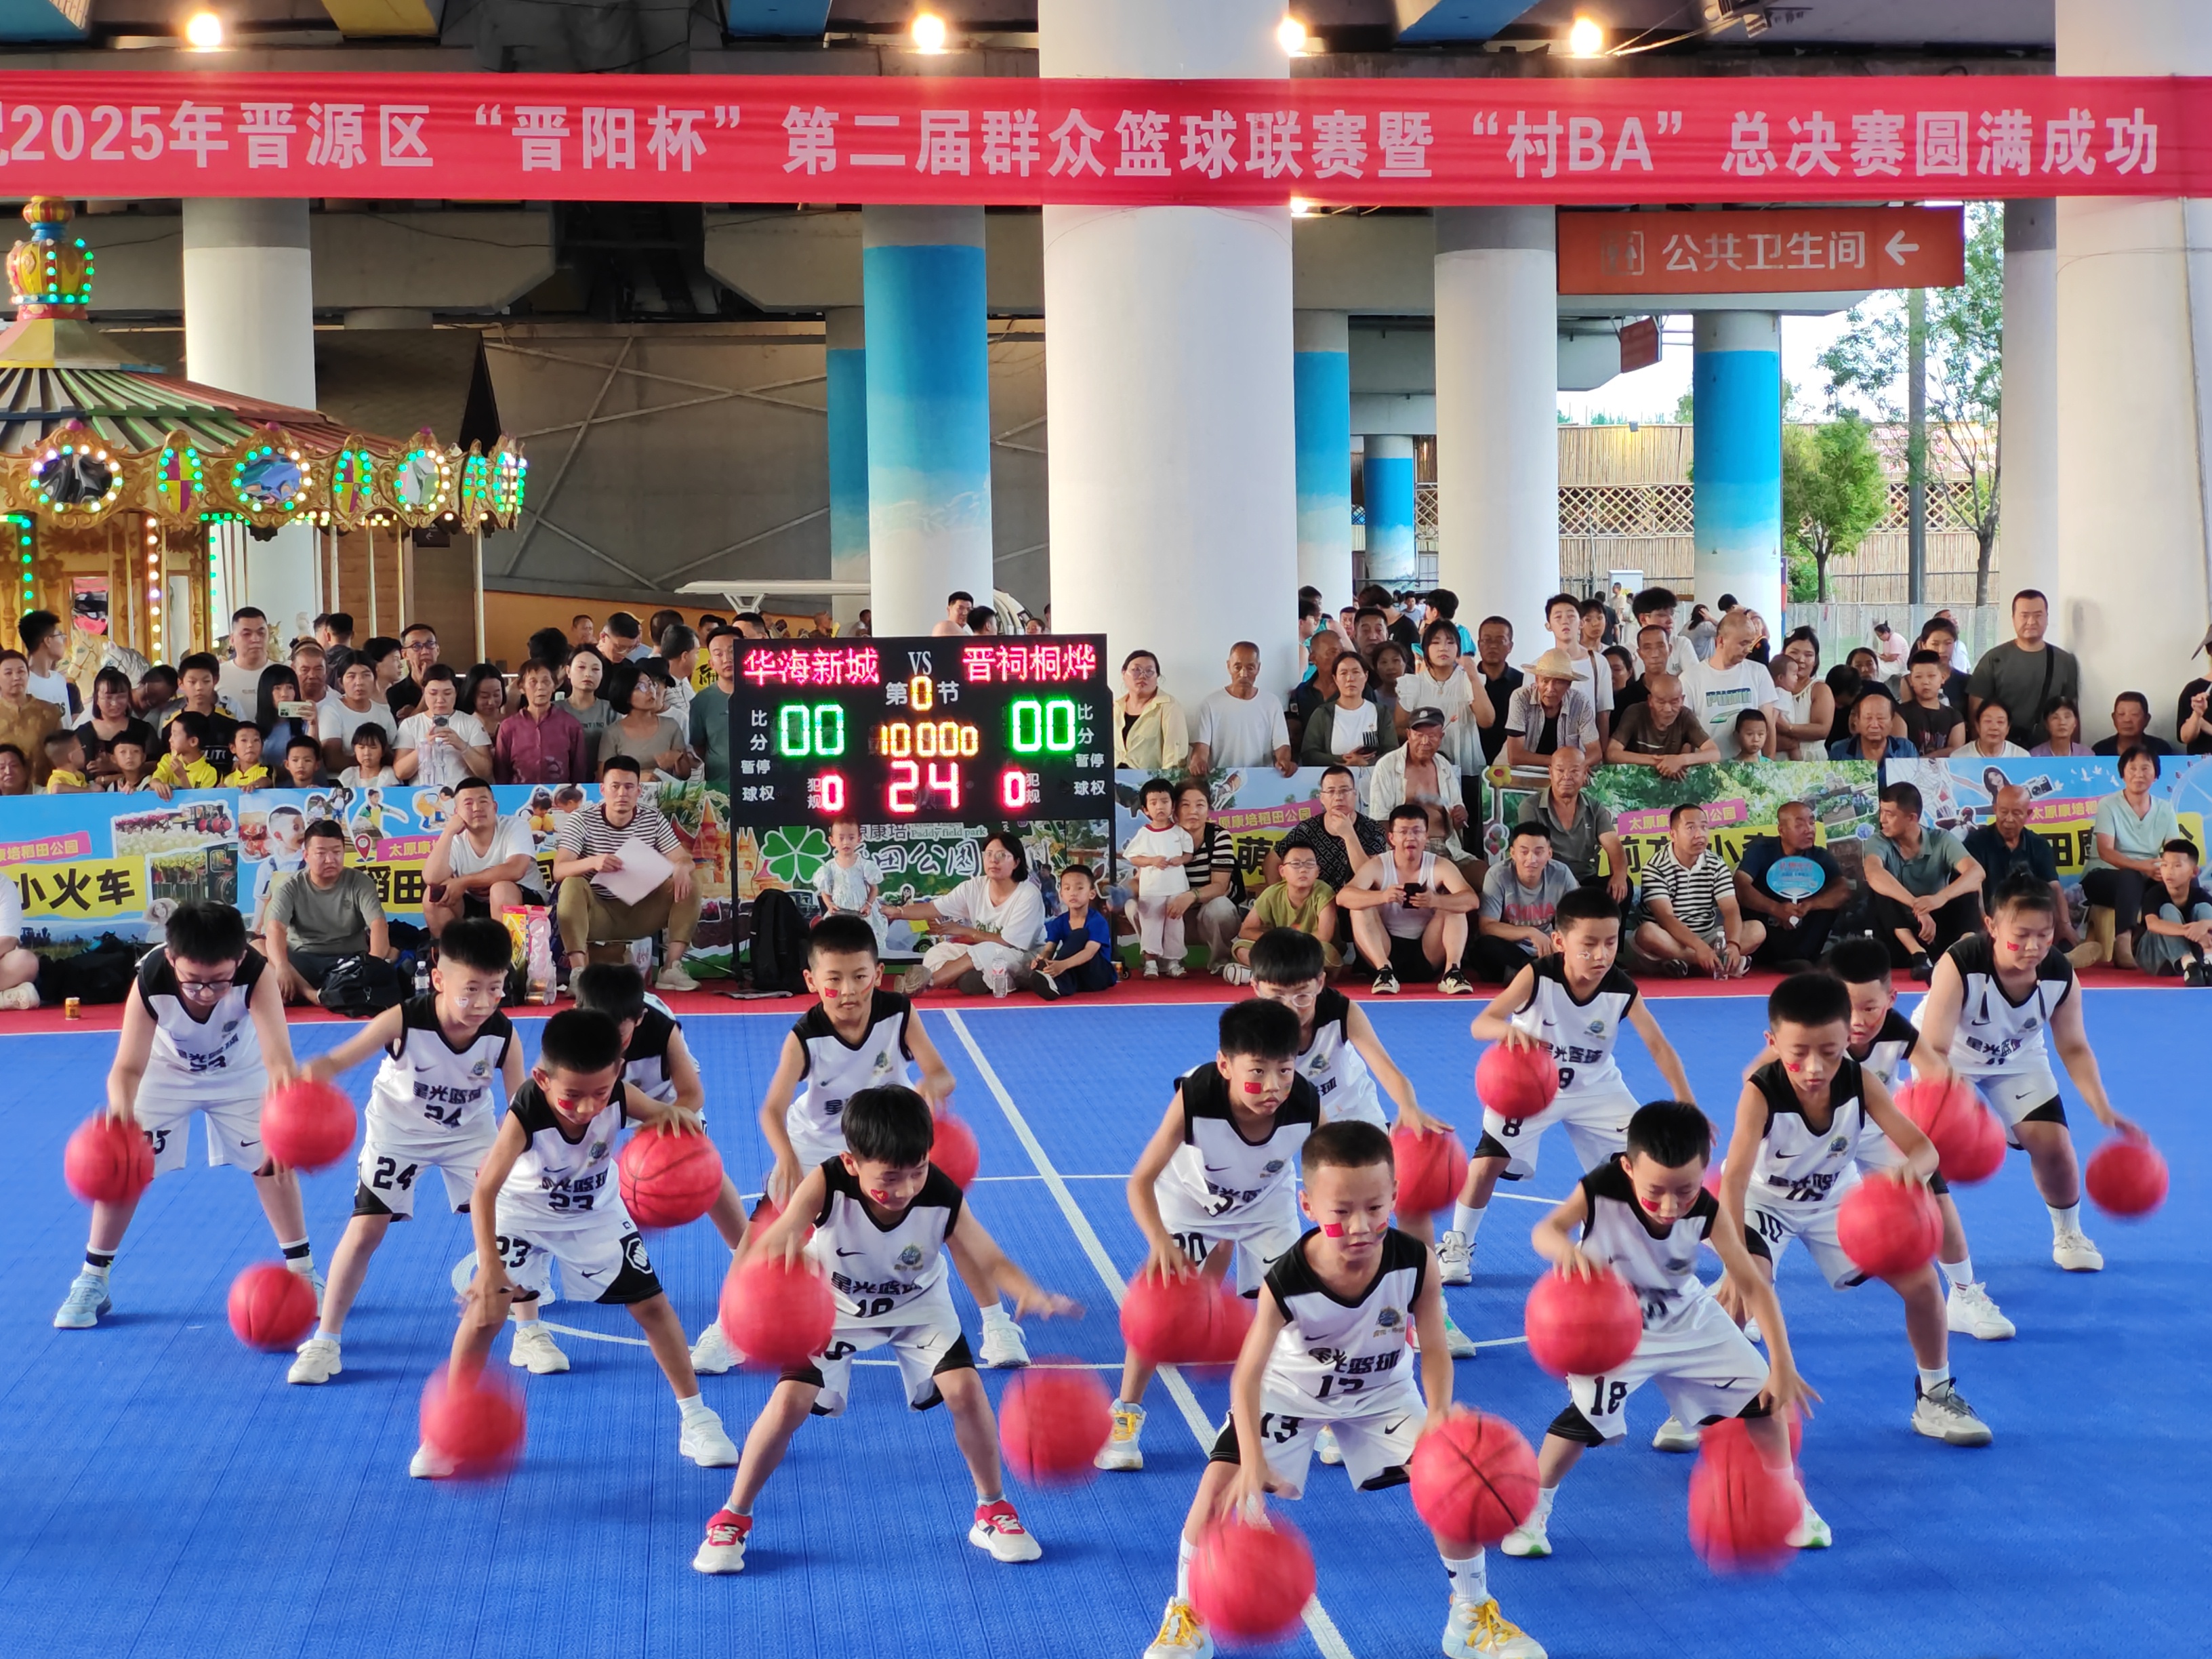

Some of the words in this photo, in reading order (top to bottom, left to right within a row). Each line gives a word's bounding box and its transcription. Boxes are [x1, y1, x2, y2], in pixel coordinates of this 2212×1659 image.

[782, 104, 1434, 180] 第二届群众篮球联赛暨
[1721, 107, 2158, 178] 总决赛圆满成功
[1662, 230, 1866, 272] 公共卫生间
[743, 646, 880, 685] 华海新城
[907, 651, 933, 676] VS
[937, 680, 960, 705] 节
[780, 704, 845, 756] 00
[1012, 699, 1076, 752] 00
[741, 760, 771, 775] 暂停
[1075, 753, 1105, 768] 暂停
[742, 785, 775, 802] 球权
[821, 775, 844, 811] 0
[888, 760, 960, 813] 24
[1003, 771, 1026, 808] 0
[1073, 780, 1106, 796] 球权
[911, 829, 941, 840] Paddy
[942, 828, 962, 838] field
[964, 827, 986, 838] park
[14, 868, 136, 912] 小火车
[373, 1156, 418, 1191] 24
[1590, 1375, 1629, 1416] 18
